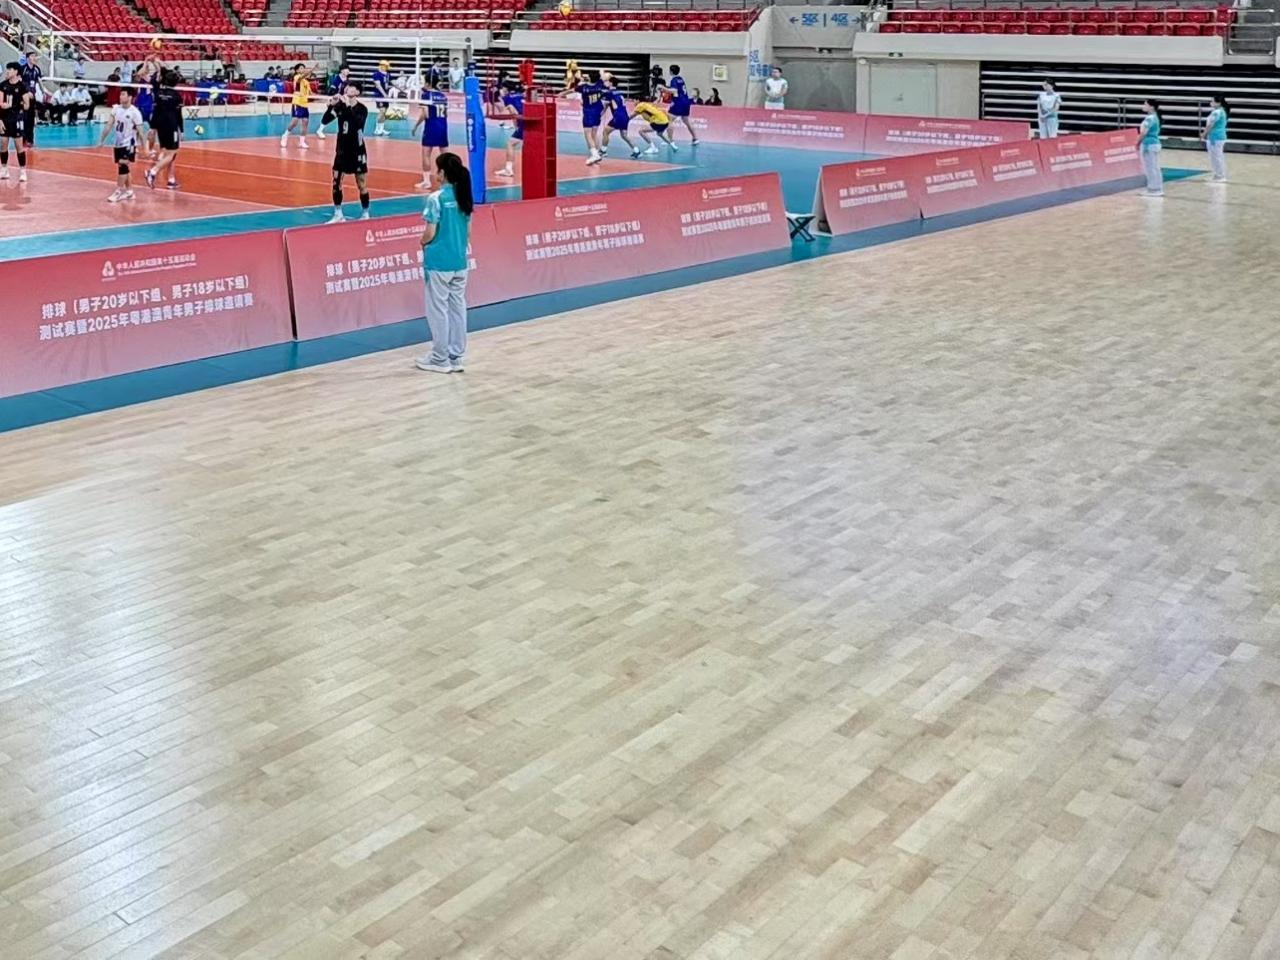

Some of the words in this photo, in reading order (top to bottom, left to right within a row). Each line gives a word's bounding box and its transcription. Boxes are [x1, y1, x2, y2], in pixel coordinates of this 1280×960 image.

[42, 275, 249, 319] 排球（男子20岁以下组、男子18岁以下组）
